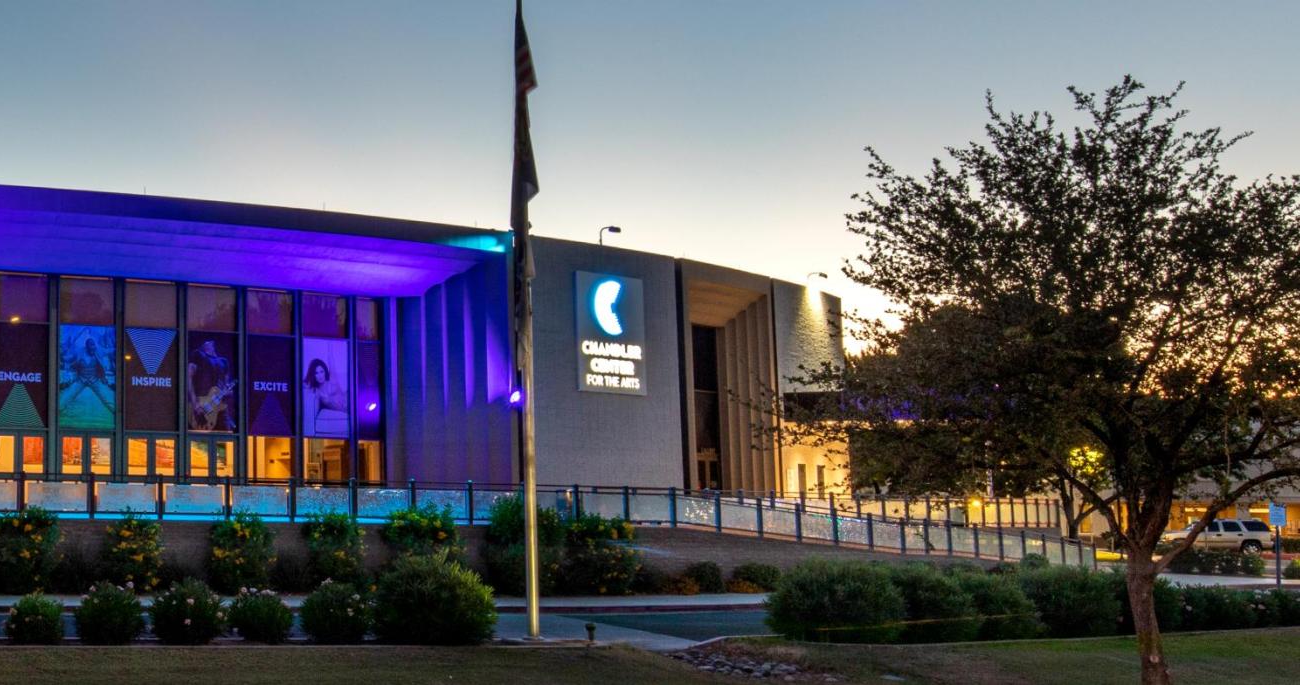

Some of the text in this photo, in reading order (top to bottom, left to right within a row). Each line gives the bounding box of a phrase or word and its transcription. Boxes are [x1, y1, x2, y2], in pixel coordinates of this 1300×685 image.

[582, 340, 642, 360] CHANDLER
[590, 357, 635, 375] CENTER
[131, 376, 172, 388] INSPIRE
[253, 381, 288, 392] EXCITE
[586, 373, 641, 389] FOR THE ARTS
